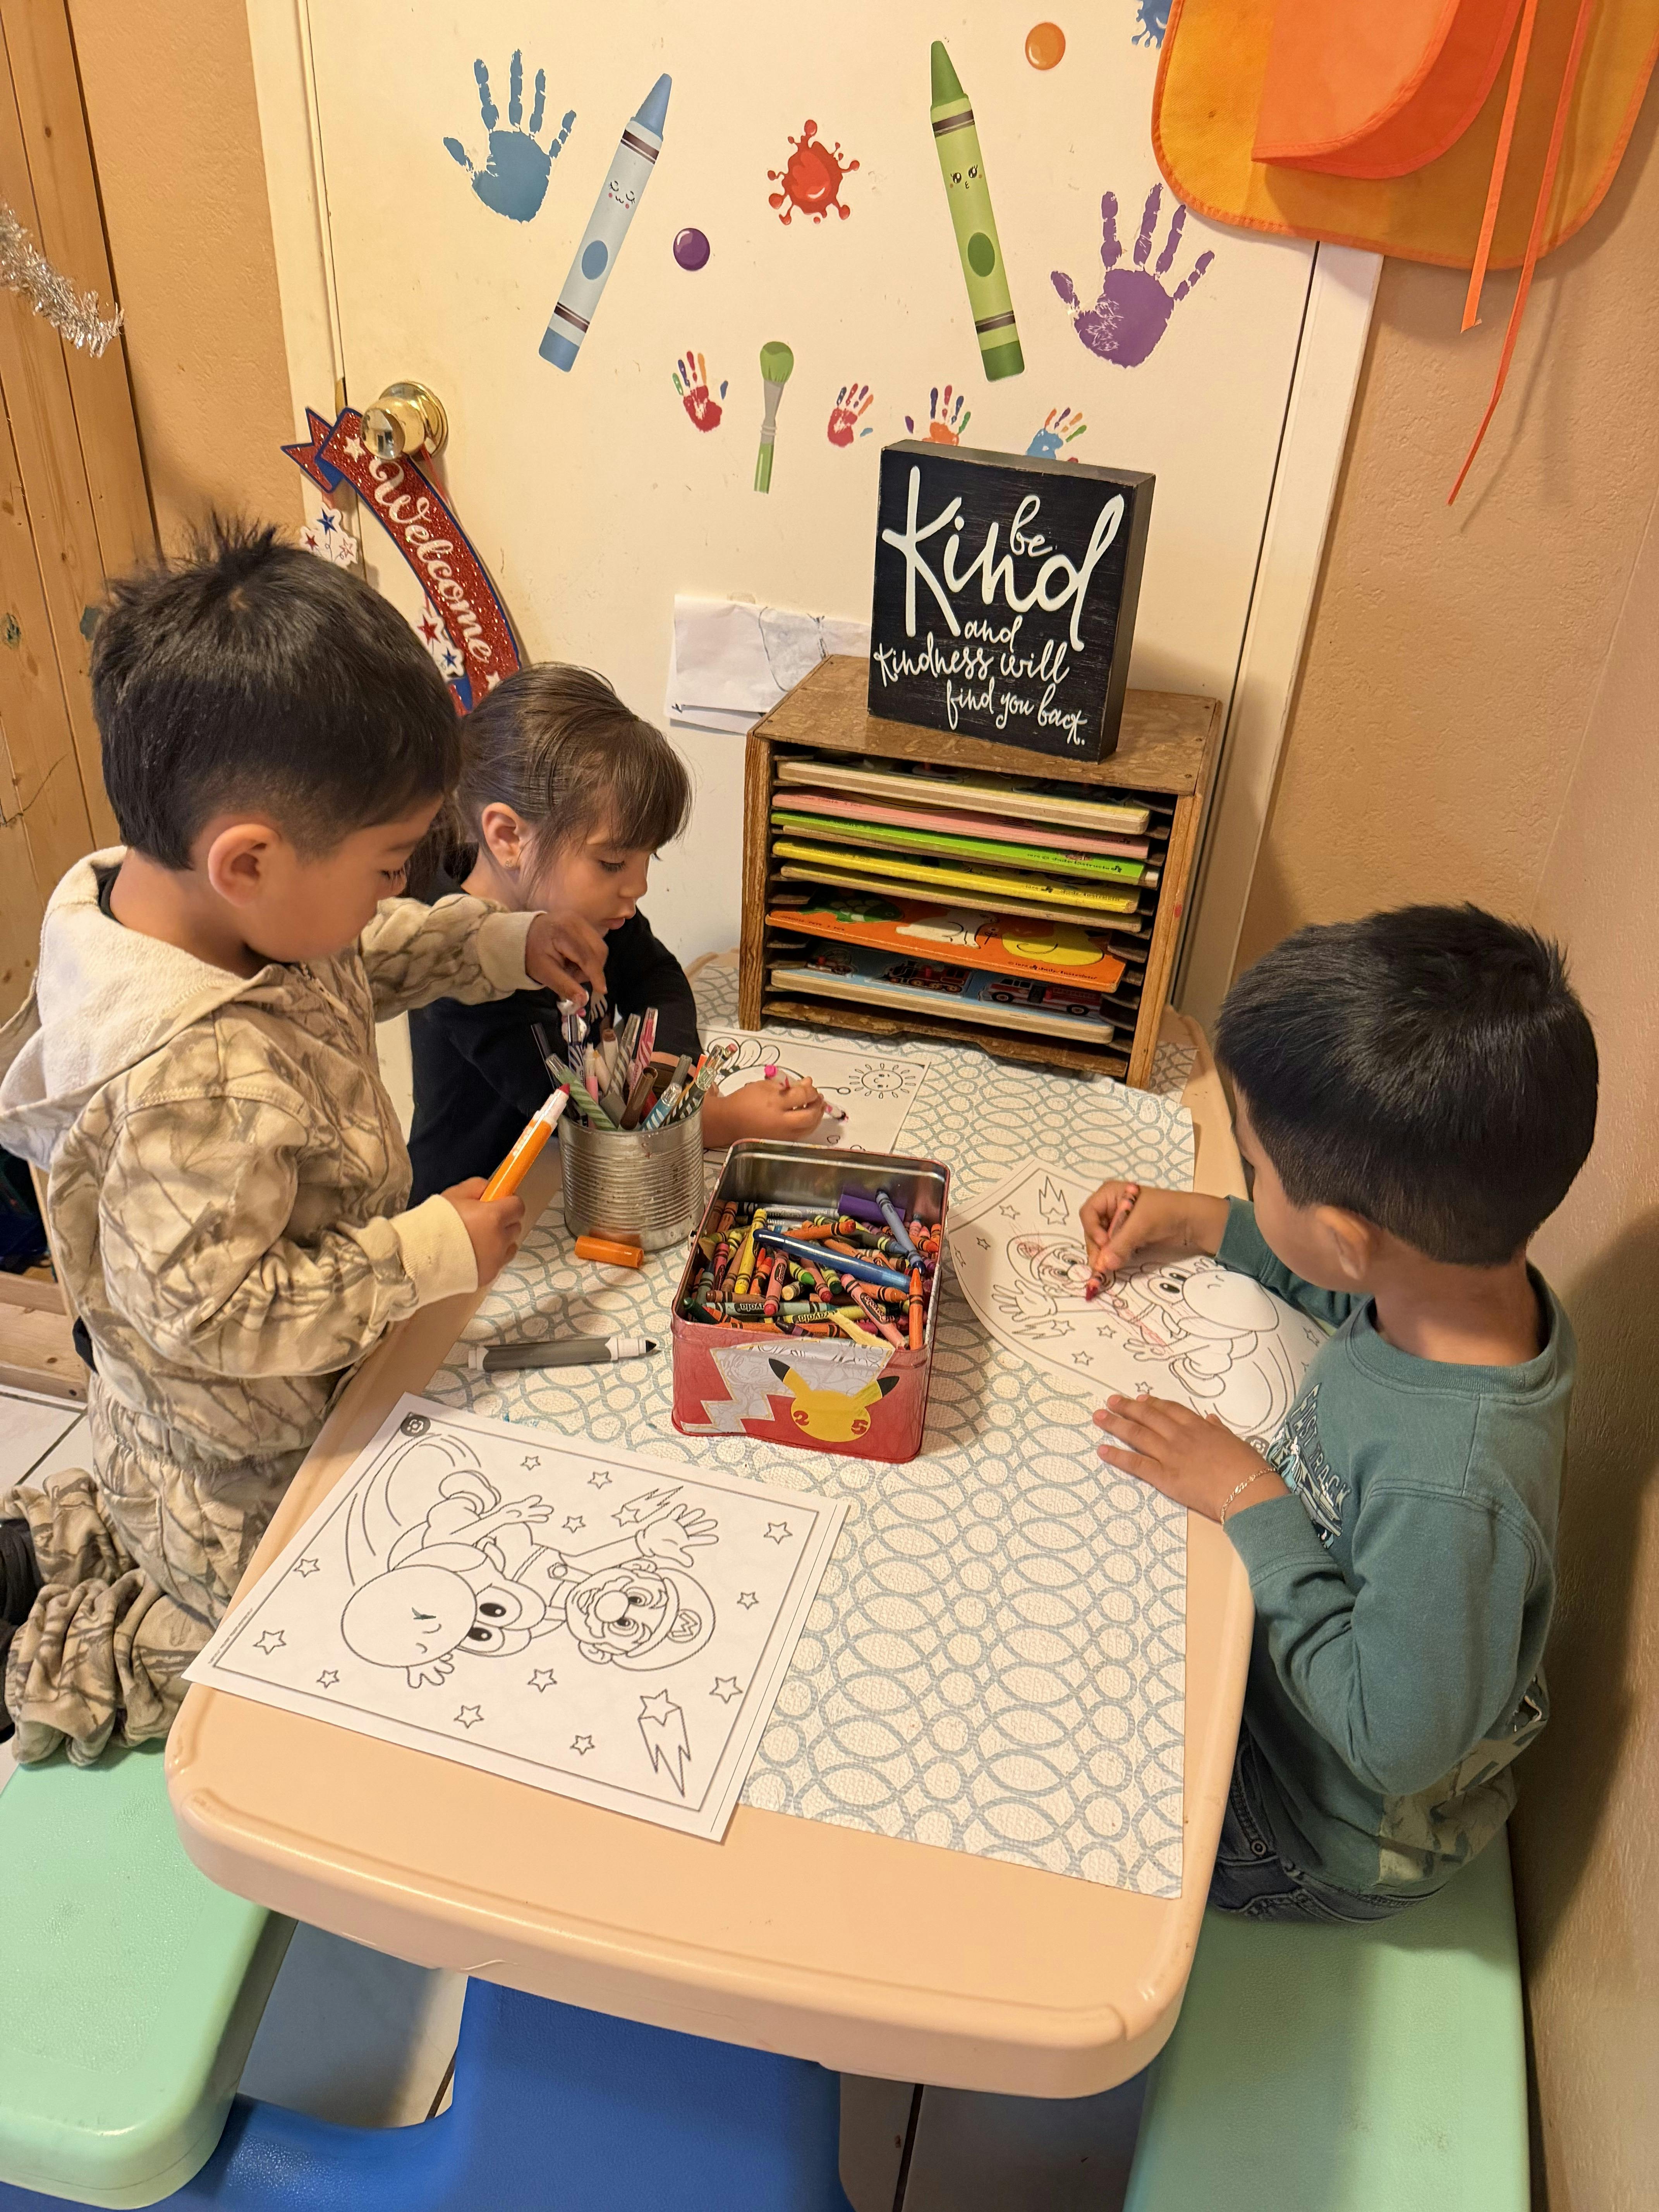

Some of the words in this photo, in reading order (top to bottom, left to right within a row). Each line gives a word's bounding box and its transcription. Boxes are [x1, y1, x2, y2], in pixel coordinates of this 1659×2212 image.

[1010, 494, 1053, 557] be
[368, 458, 492, 664] Welcome
[964, 615, 1023, 653] and
[1000, 639, 1070, 684] will
[946, 677, 995, 730] find
[996, 694, 1035, 730] you
[793, 1410, 809, 1426] 2
[851, 1419, 868, 1435] 5
[1290, 1382, 1322, 1447] FAST
